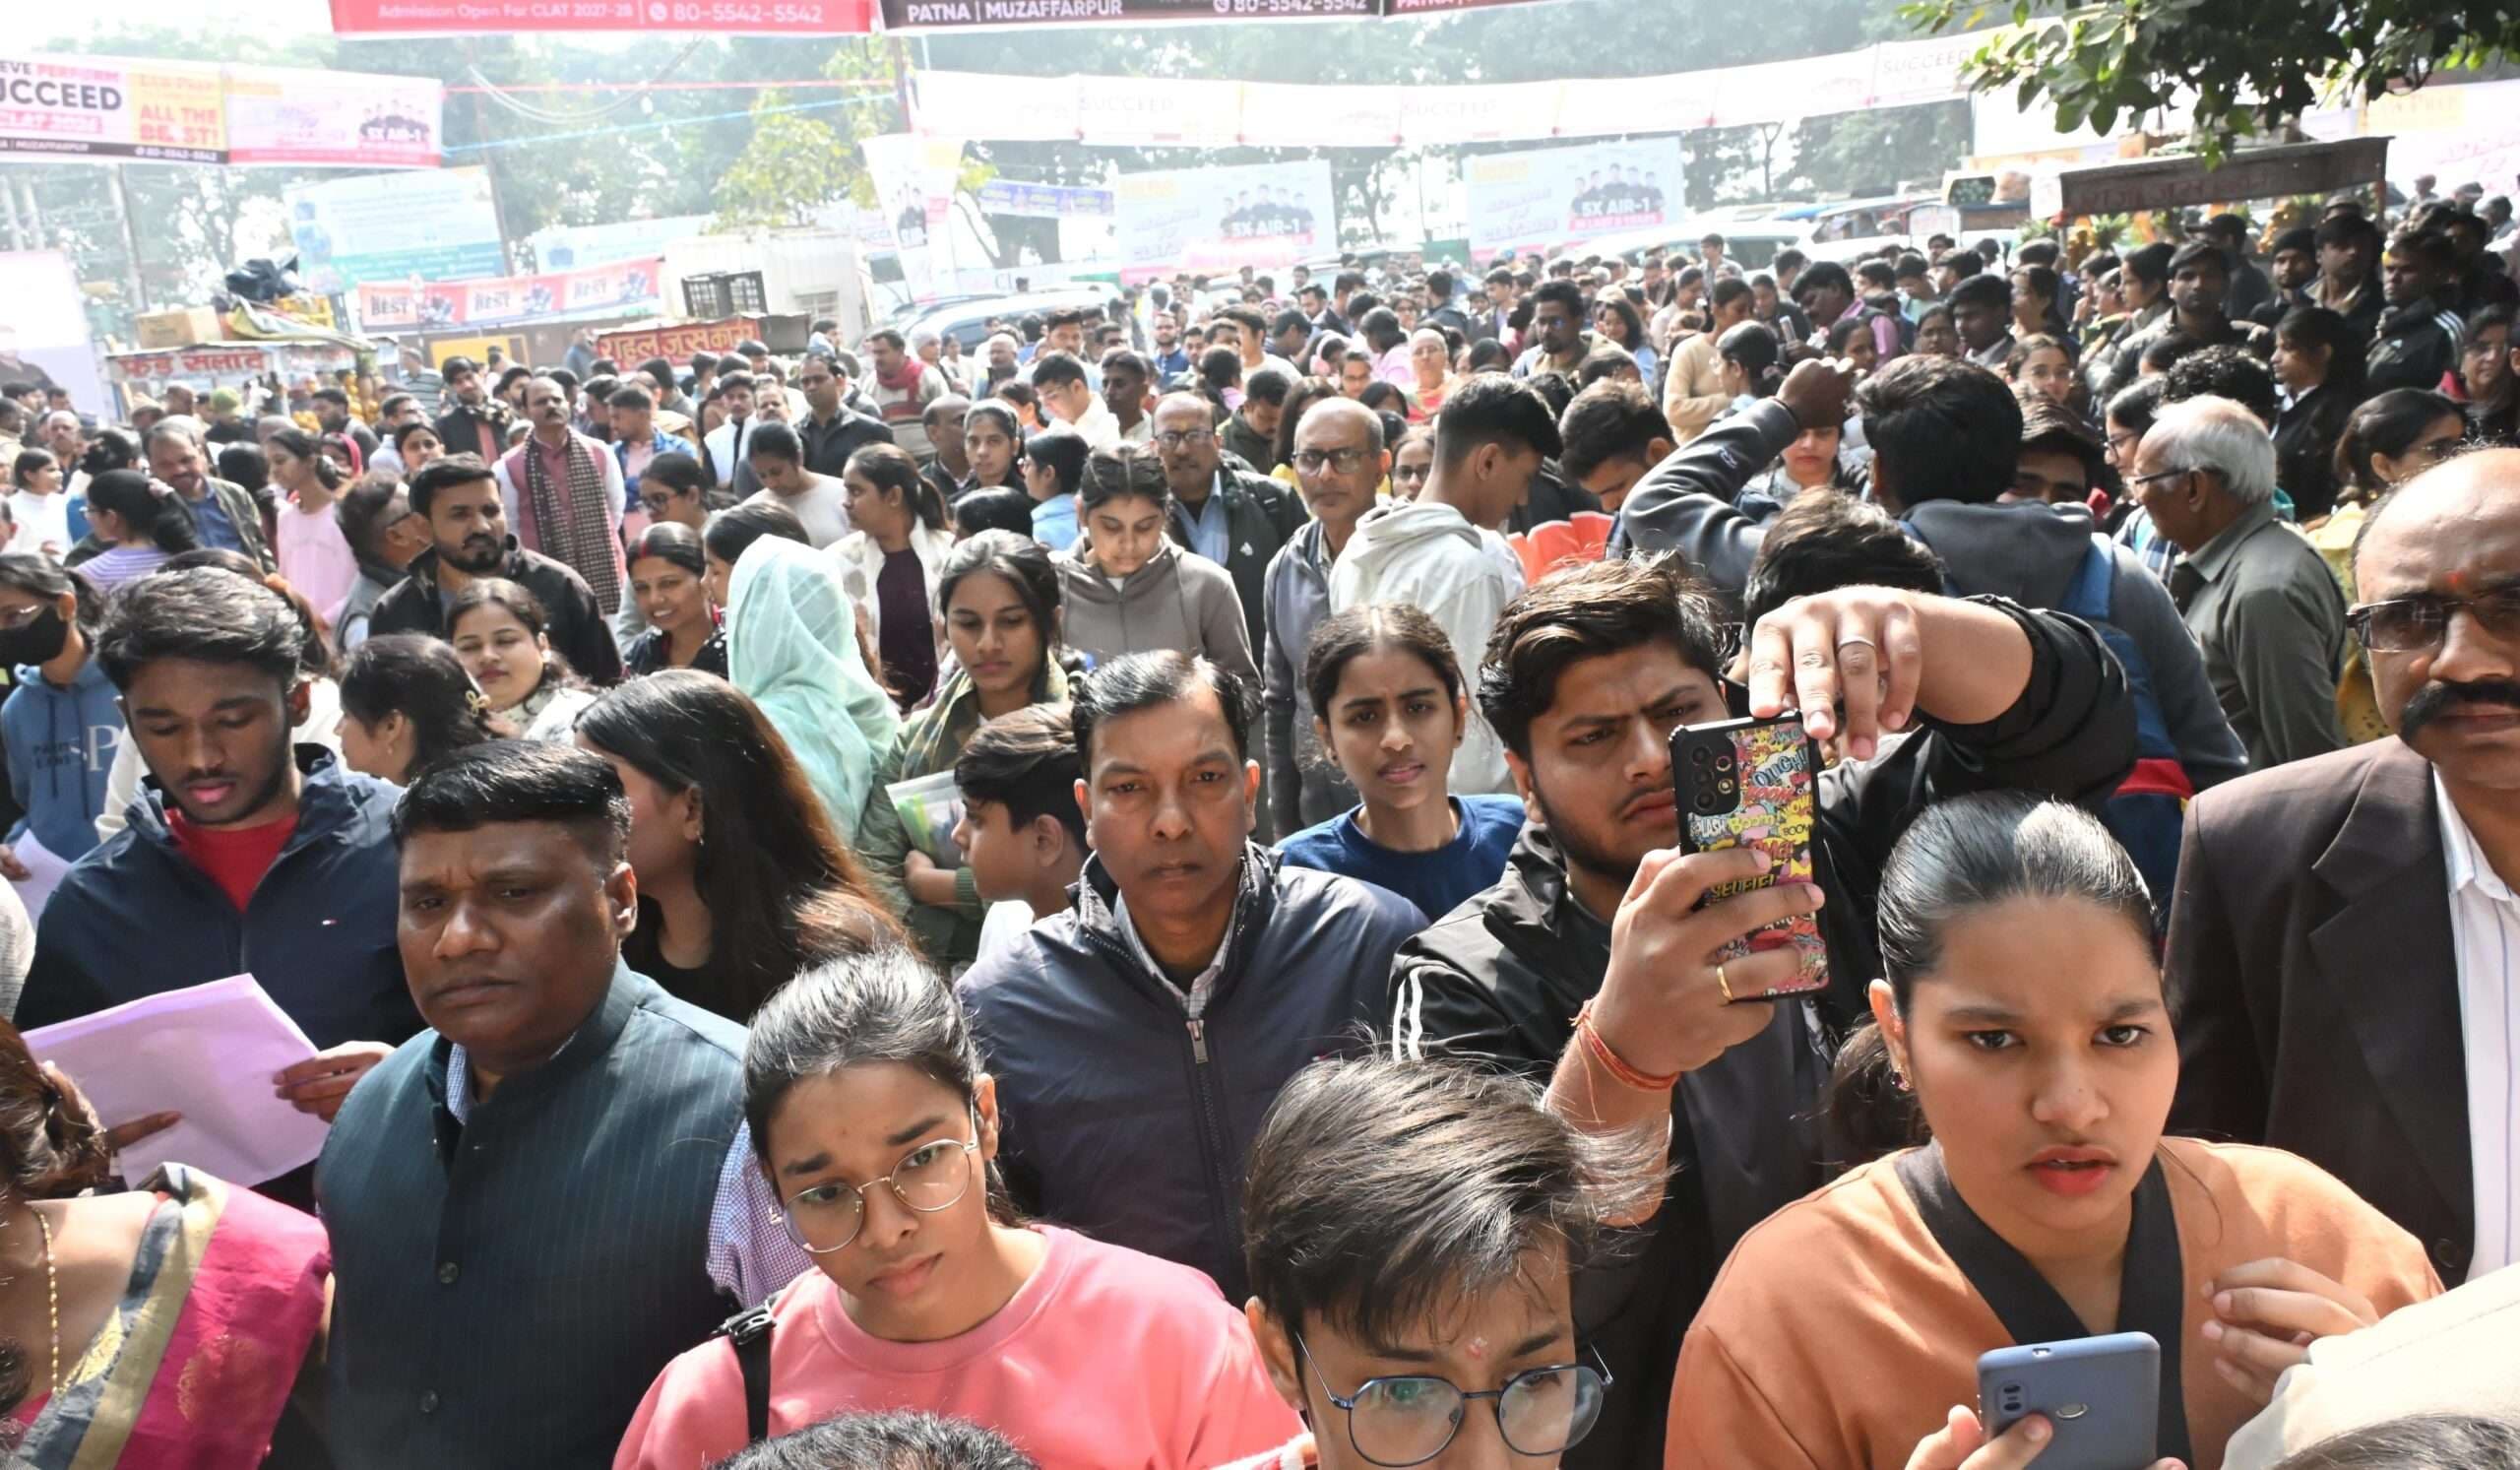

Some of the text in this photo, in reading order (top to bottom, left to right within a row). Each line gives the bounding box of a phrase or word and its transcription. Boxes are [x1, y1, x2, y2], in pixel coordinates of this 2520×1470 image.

[378, 4, 454, 17] Admission
[458, 4, 499, 20] Open
[504, 4, 526, 17] For
[531, 3, 568, 17] CLAT
[673, 4, 823, 23] 80-5542-5542
[908, 4, 971, 23] PATNA
[985, 0, 1123, 19] MUZAFFARPUR
[141, 104, 217, 124] ALL THE
[1606, 196, 1651, 215] AIR-1
[370, 294, 409, 316] BEST
[474, 290, 511, 311] BEST
[1752, 747, 1809, 789] OUCH!!
